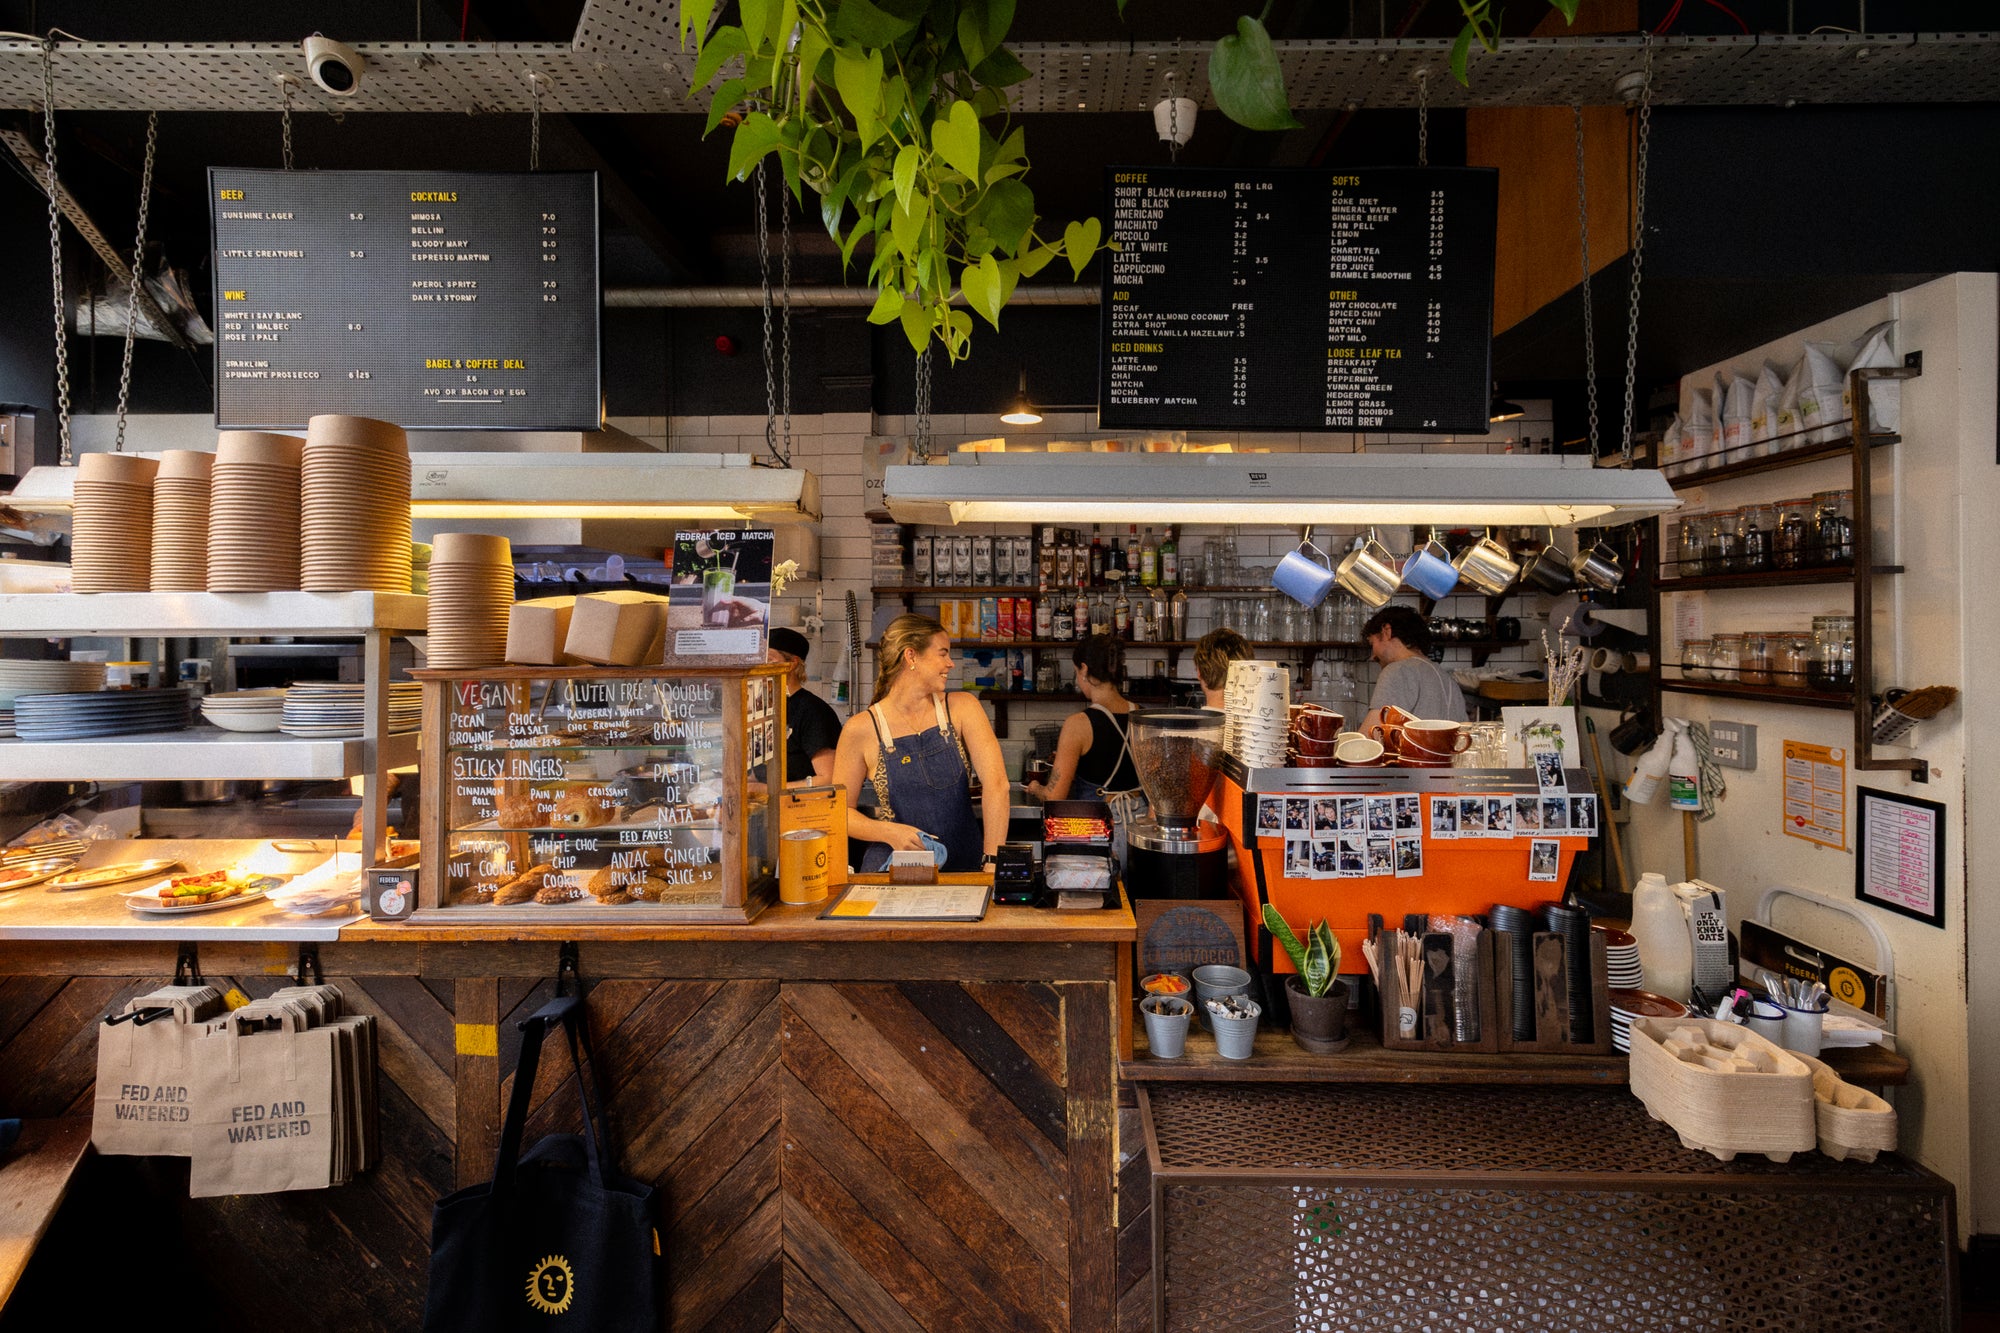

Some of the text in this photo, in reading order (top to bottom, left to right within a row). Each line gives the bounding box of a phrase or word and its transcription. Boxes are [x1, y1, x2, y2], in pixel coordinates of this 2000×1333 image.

[1114, 173, 1148, 184] COFFEE
[1332, 176, 1360, 186] SOFTS
[220, 190, 244, 200] BEER
[411, 192, 457, 202] COCKTAILS
[1114, 187, 1142, 197] SHORT
[1147, 188, 1175, 198] BLACK
[1114, 199, 1170, 208] LONG BLACK
[222, 212, 263, 220] SUNSHINE
[265, 212, 294, 220] LAGER
[411, 213, 441, 221] MIMOSA
[1114, 209, 1164, 219] AMERICANO
[1114, 220, 1158, 230] MACHIATO
[1114, 231, 1149, 241] PICCOLO
[446, 240, 468, 248] MARY
[1141, 242, 1168, 252] WHITE
[223, 250, 304, 258] LITTLE CREATURES
[1114, 253, 1141, 263] LATTE
[1113, 264, 1165, 274] CAPPUCCINO
[1113, 275, 1143, 285] MOCHA
[224, 290, 246, 300] WINE
[412, 294, 477, 302] DARK STORMY
[1113, 291, 1130, 301] ADD
[1330, 291, 1357, 300] OTHER
[275, 312, 302, 320] BLANC
[1156, 313, 1189, 321] ALMOND
[1191, 313, 1230, 321] COCONUT
[1112, 321, 1167, 329] EXTRA SHOT
[1112, 329, 1150, 337] CARAMEL
[1111, 343, 1164, 353] ICED DRINKS
[1328, 349, 1401, 358] LOOSE LEAF TEA
[225, 360, 268, 368] SPARKLING
[425, 359, 525, 369] BAGEL COFFEE DEAL
[270, 371, 320, 379] PROSSECCO
[1326, 416, 1353, 426] BATCH
[1358, 416, 1383, 426] BREW
[675, 532, 775, 541] FEDERAL ICED MATCHA
[564, 683, 615, 702] GLUTEN
[662, 683, 711, 701] DOUBLE
[567, 708, 612, 720] RASPBERRY
[661, 704, 695, 719] CHOC
[450, 712, 485, 729] PECAN
[509, 713, 535, 726] CHOC
[509, 725, 549, 736] SEA SALT
[567, 723, 587, 732] CHOC
[653, 721, 706, 741] BROWNIE
[449, 730, 495, 746] BROWNIE
[454, 757, 505, 777] STICKY
[653, 763, 704, 784] PASTEL
[457, 786, 504, 796] CINNAMON
[530, 788, 566, 800] PAIN AU
[587, 787, 629, 797] CROISSANT
[666, 786, 682, 803] DE
[471, 797, 491, 806] ROLL
[537, 803, 558, 813] CHOC
[657, 807, 694, 824] NATA
[620, 831, 639, 842] FED
[534, 839, 598, 854] WHITE CHOC
[552, 856, 577, 869] CHIP
[611, 851, 651, 869] ANZAC
[664, 847, 713, 868] GINGER
[447, 862, 472, 878] NUT
[611, 870, 649, 886] BIKKIE
[666, 870, 695, 885] SLICE
[1696, 926, 1724, 934] KNOW
[1698, 933, 1725, 941] OATS
[121, 1084, 188, 1103] FED AND
[115, 1104, 190, 1122] WATERED
[232, 1101, 306, 1123] FED AND
[227, 1120, 311, 1144] WATERED
